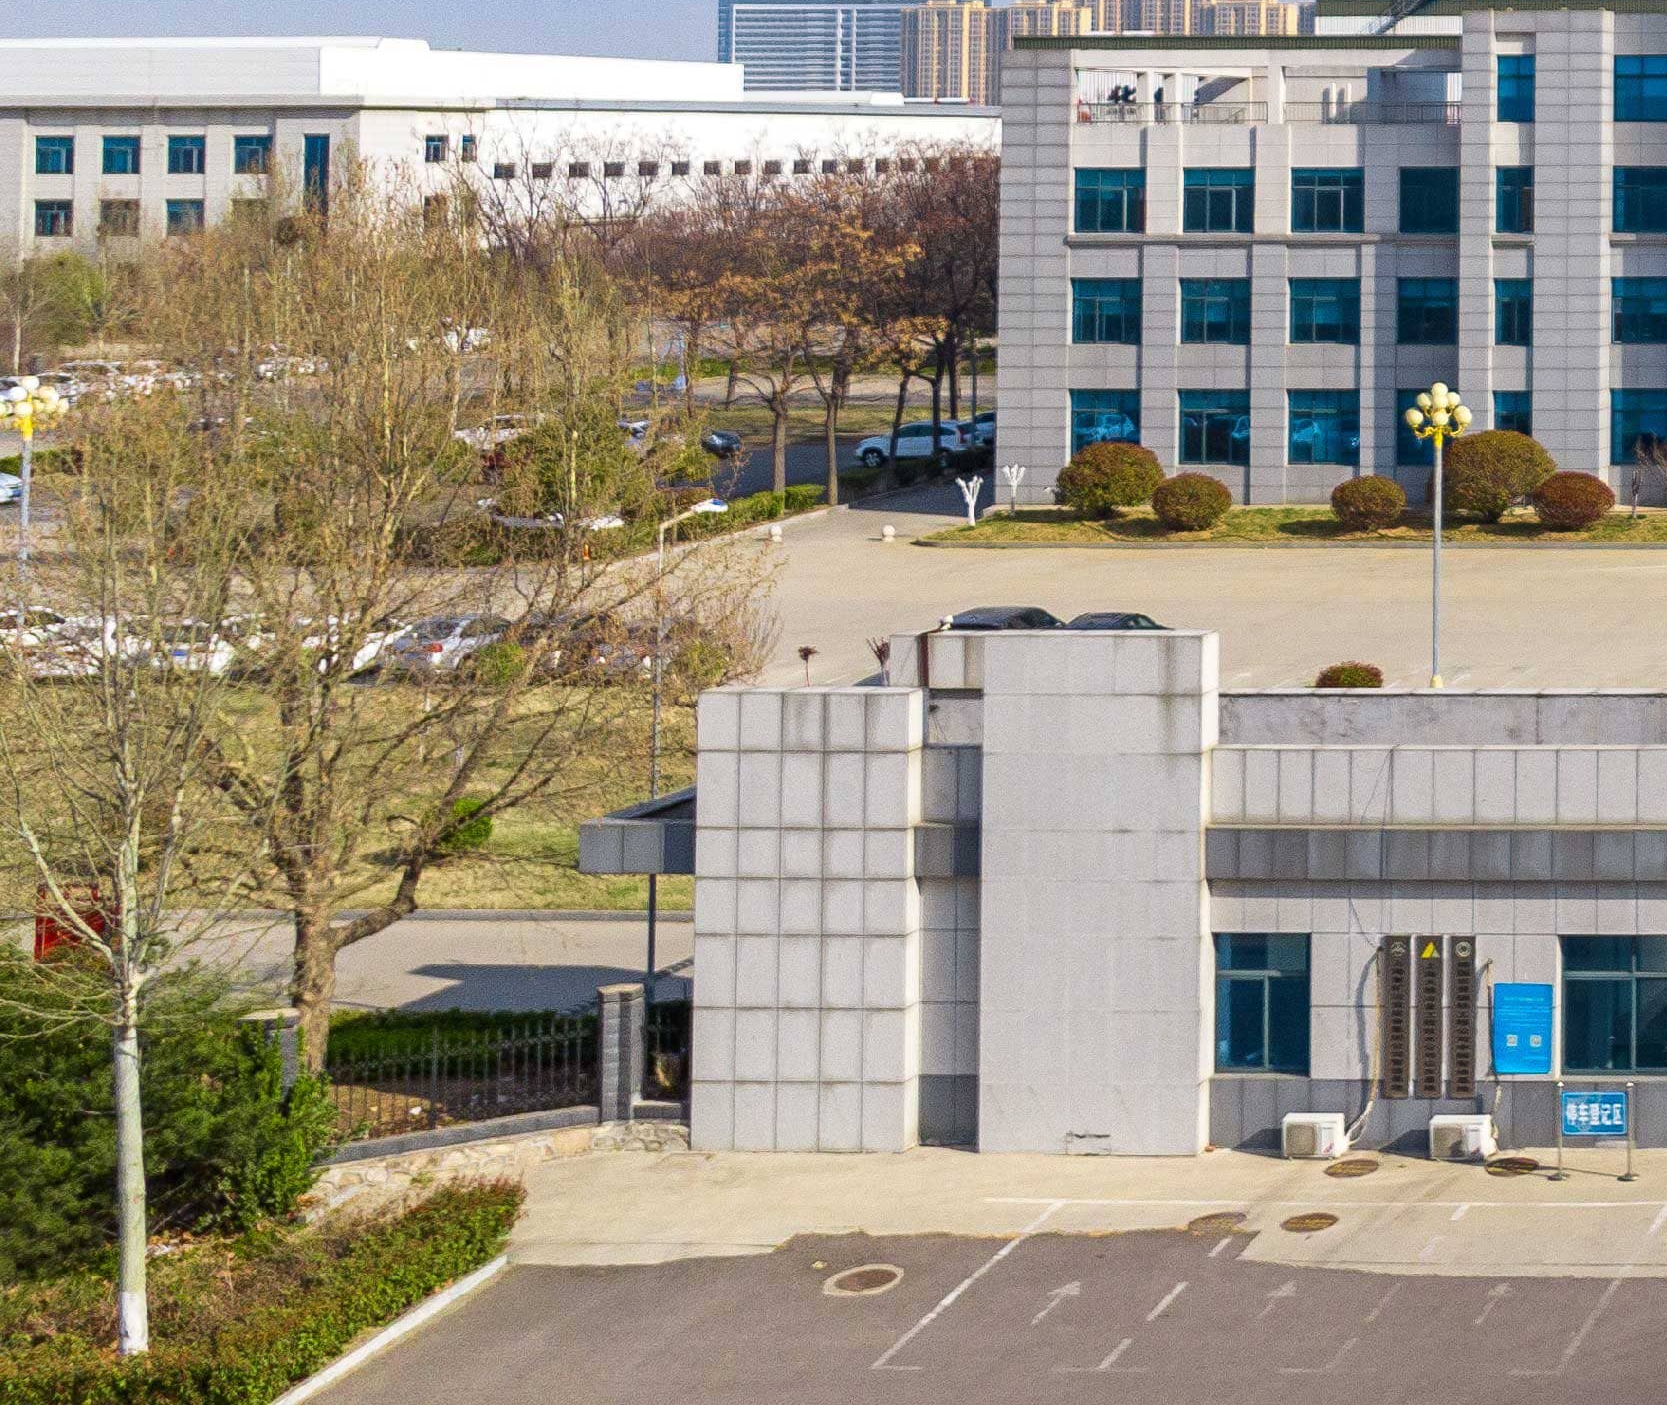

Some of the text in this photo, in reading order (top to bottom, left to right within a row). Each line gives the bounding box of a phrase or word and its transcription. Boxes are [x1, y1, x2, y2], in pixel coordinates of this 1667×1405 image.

[1567, 1103, 1624, 1126] 停车登记区
